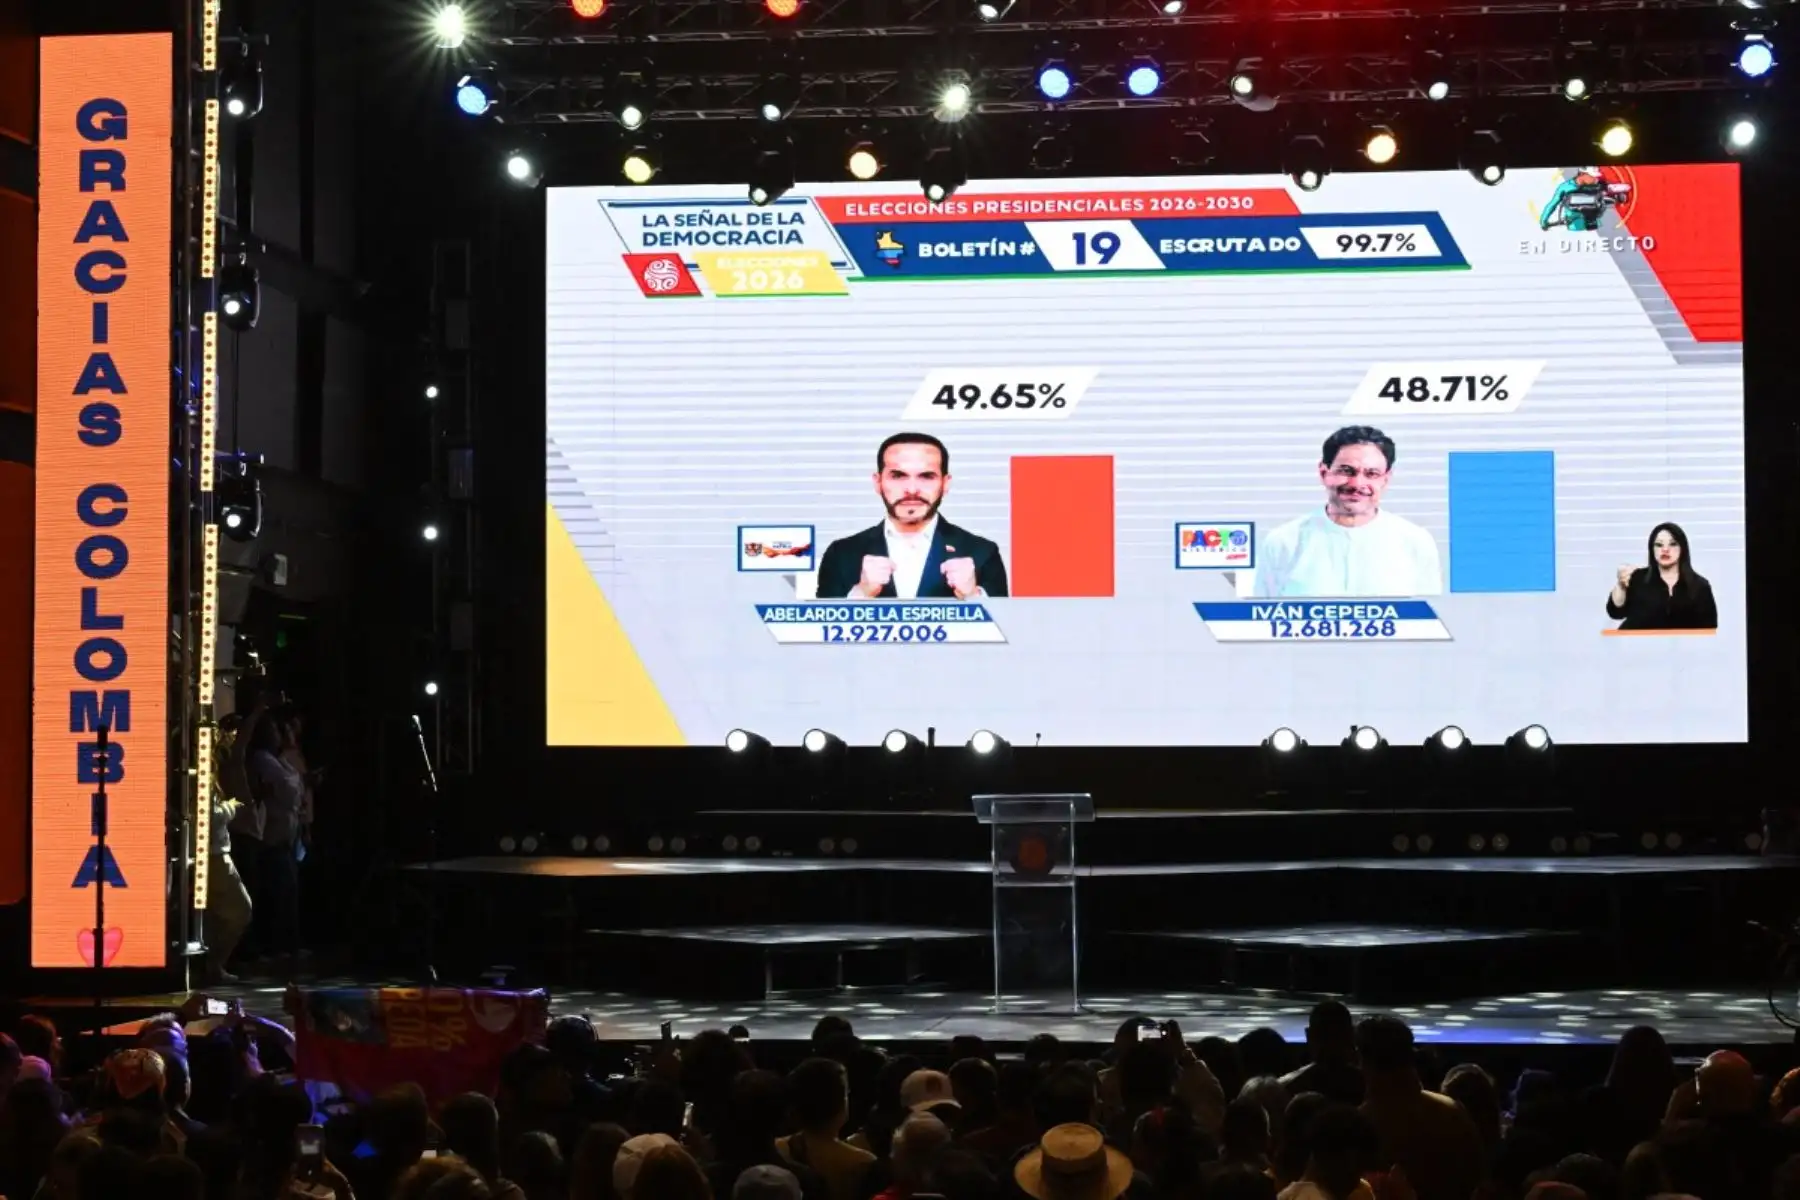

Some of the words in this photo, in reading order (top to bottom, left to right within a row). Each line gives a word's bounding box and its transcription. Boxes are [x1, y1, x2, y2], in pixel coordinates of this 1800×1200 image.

[845, 200, 968, 217] ELECCIONES
[973, 198, 1144, 214] PRESIDENCIALES
[1150, 196, 1254, 211] 2026-2030
[642, 213, 670, 228] LA
[674, 209, 743, 227] SEÑAL
[747, 212, 774, 226] DE
[777, 212, 805, 226] LA
[642, 229, 804, 247] DEMOCRACIA
[919, 238, 1016, 258] BOLETÍN
[1335, 232, 1416, 253] 99.7%
[1518, 239, 1546, 255] EN
[1559, 235, 1656, 254] DIRECTO
[1072, 231, 1121, 266] 19
[73, 97, 129, 447] GRACIAS
[731, 270, 805, 291] 2026
[931, 382, 1067, 410] 49.65%
[1378, 374, 1510, 403] 48.71%
[1182, 528, 1248, 547] PACTO
[763, 606, 850, 622] ABELARDO
[853, 606, 875, 621] DE
[878, 606, 899, 621] LA
[902, 605, 985, 621] ESPRIELLA
[1251, 602, 1304, 620] IVÁN
[1309, 604, 1399, 620] CEPEDA
[822, 624, 947, 642] 12.927.006
[1270, 619, 1397, 638] 12.681.268
[69, 483, 131, 889] COLOMBIA
